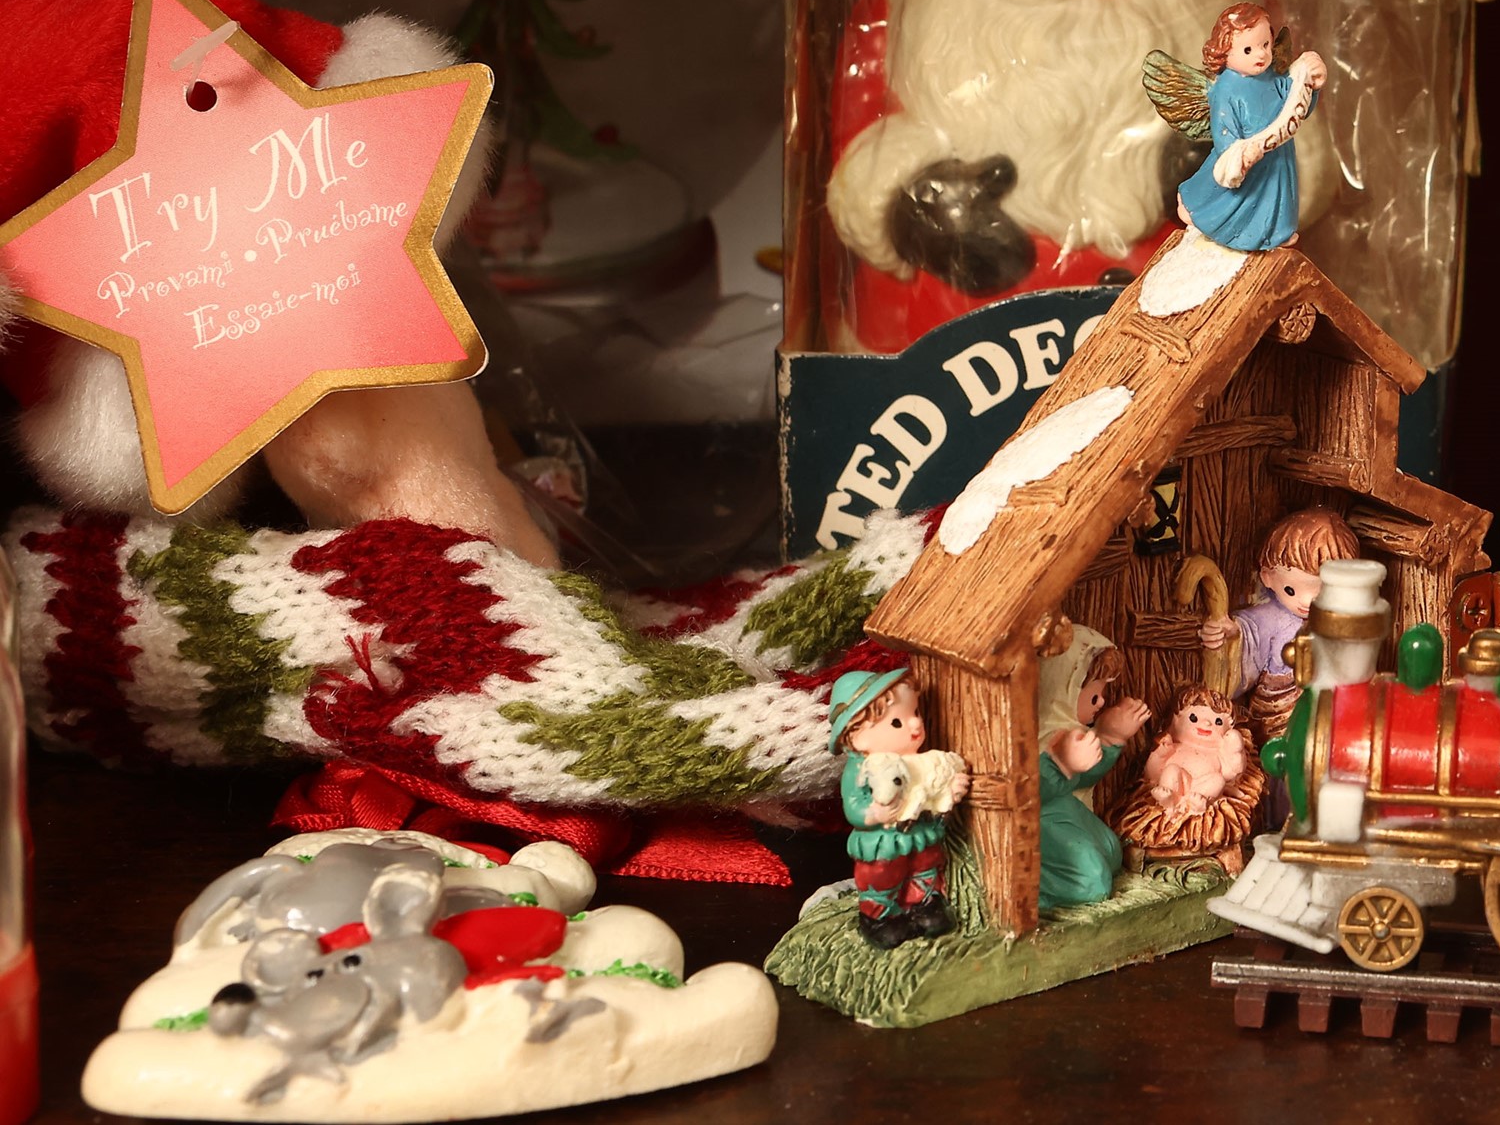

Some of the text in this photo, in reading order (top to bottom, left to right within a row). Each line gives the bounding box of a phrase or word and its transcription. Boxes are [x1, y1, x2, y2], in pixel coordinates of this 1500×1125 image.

[88, 112, 369, 264] Try Me
[96, 200, 410, 319] Provami Pruébame
[183, 262, 362, 351] Essaie-moi
